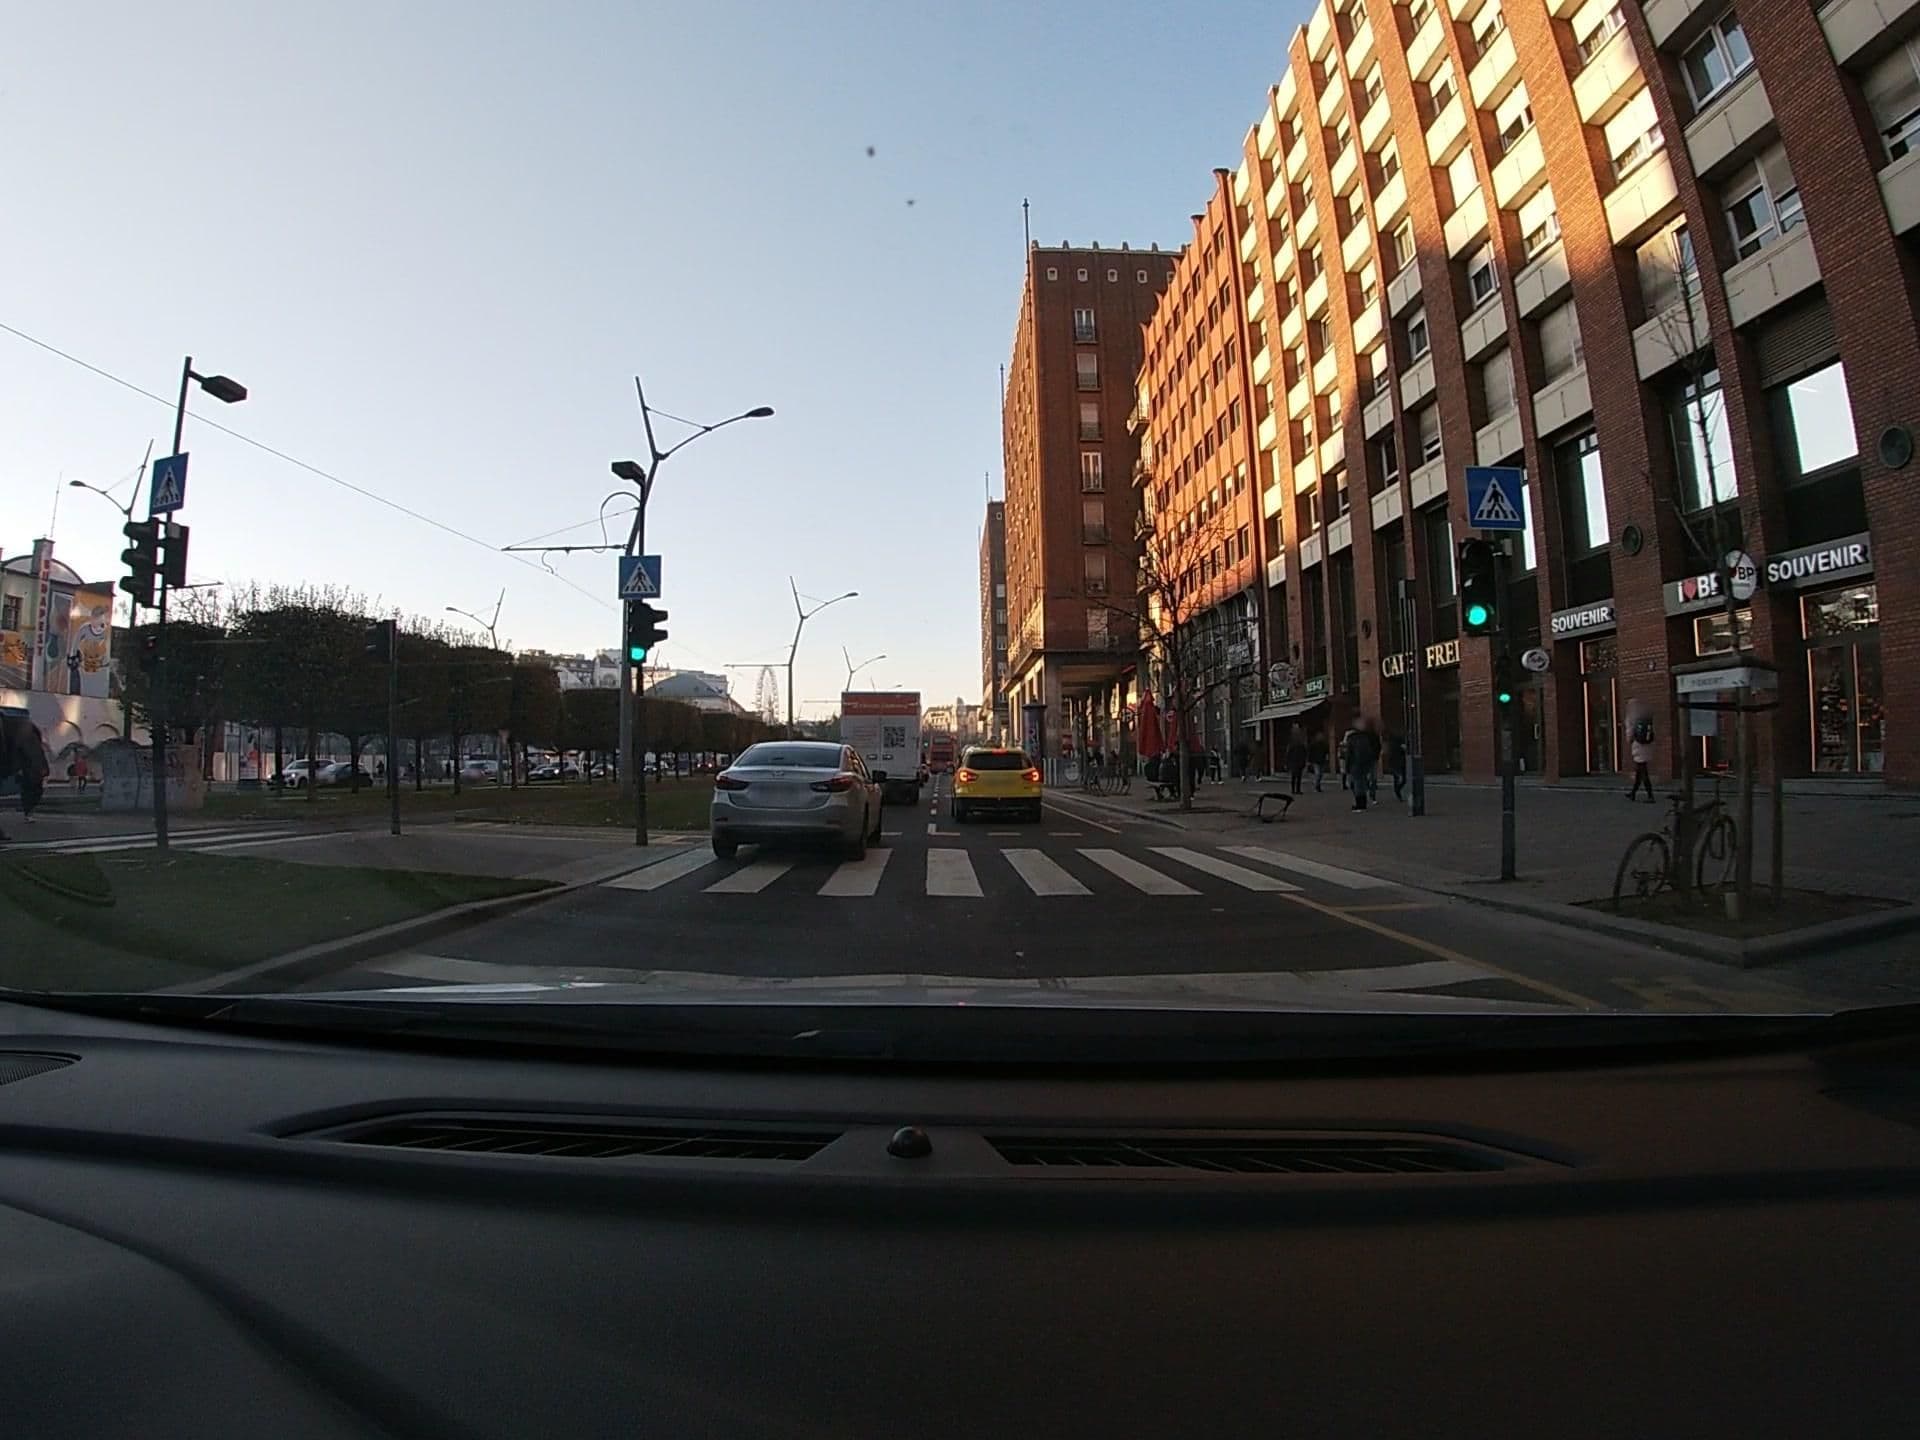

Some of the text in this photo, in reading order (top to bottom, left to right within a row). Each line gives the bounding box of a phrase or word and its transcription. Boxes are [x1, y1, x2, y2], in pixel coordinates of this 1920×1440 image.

[1738, 566, 1754, 580] BP
[1766, 543, 1866, 583] SOUVENIR
[37, 559, 50, 657] BUDAPEST
[1551, 606, 1610, 633] SOUVENIR
[1425, 640, 1461, 669] FREI
